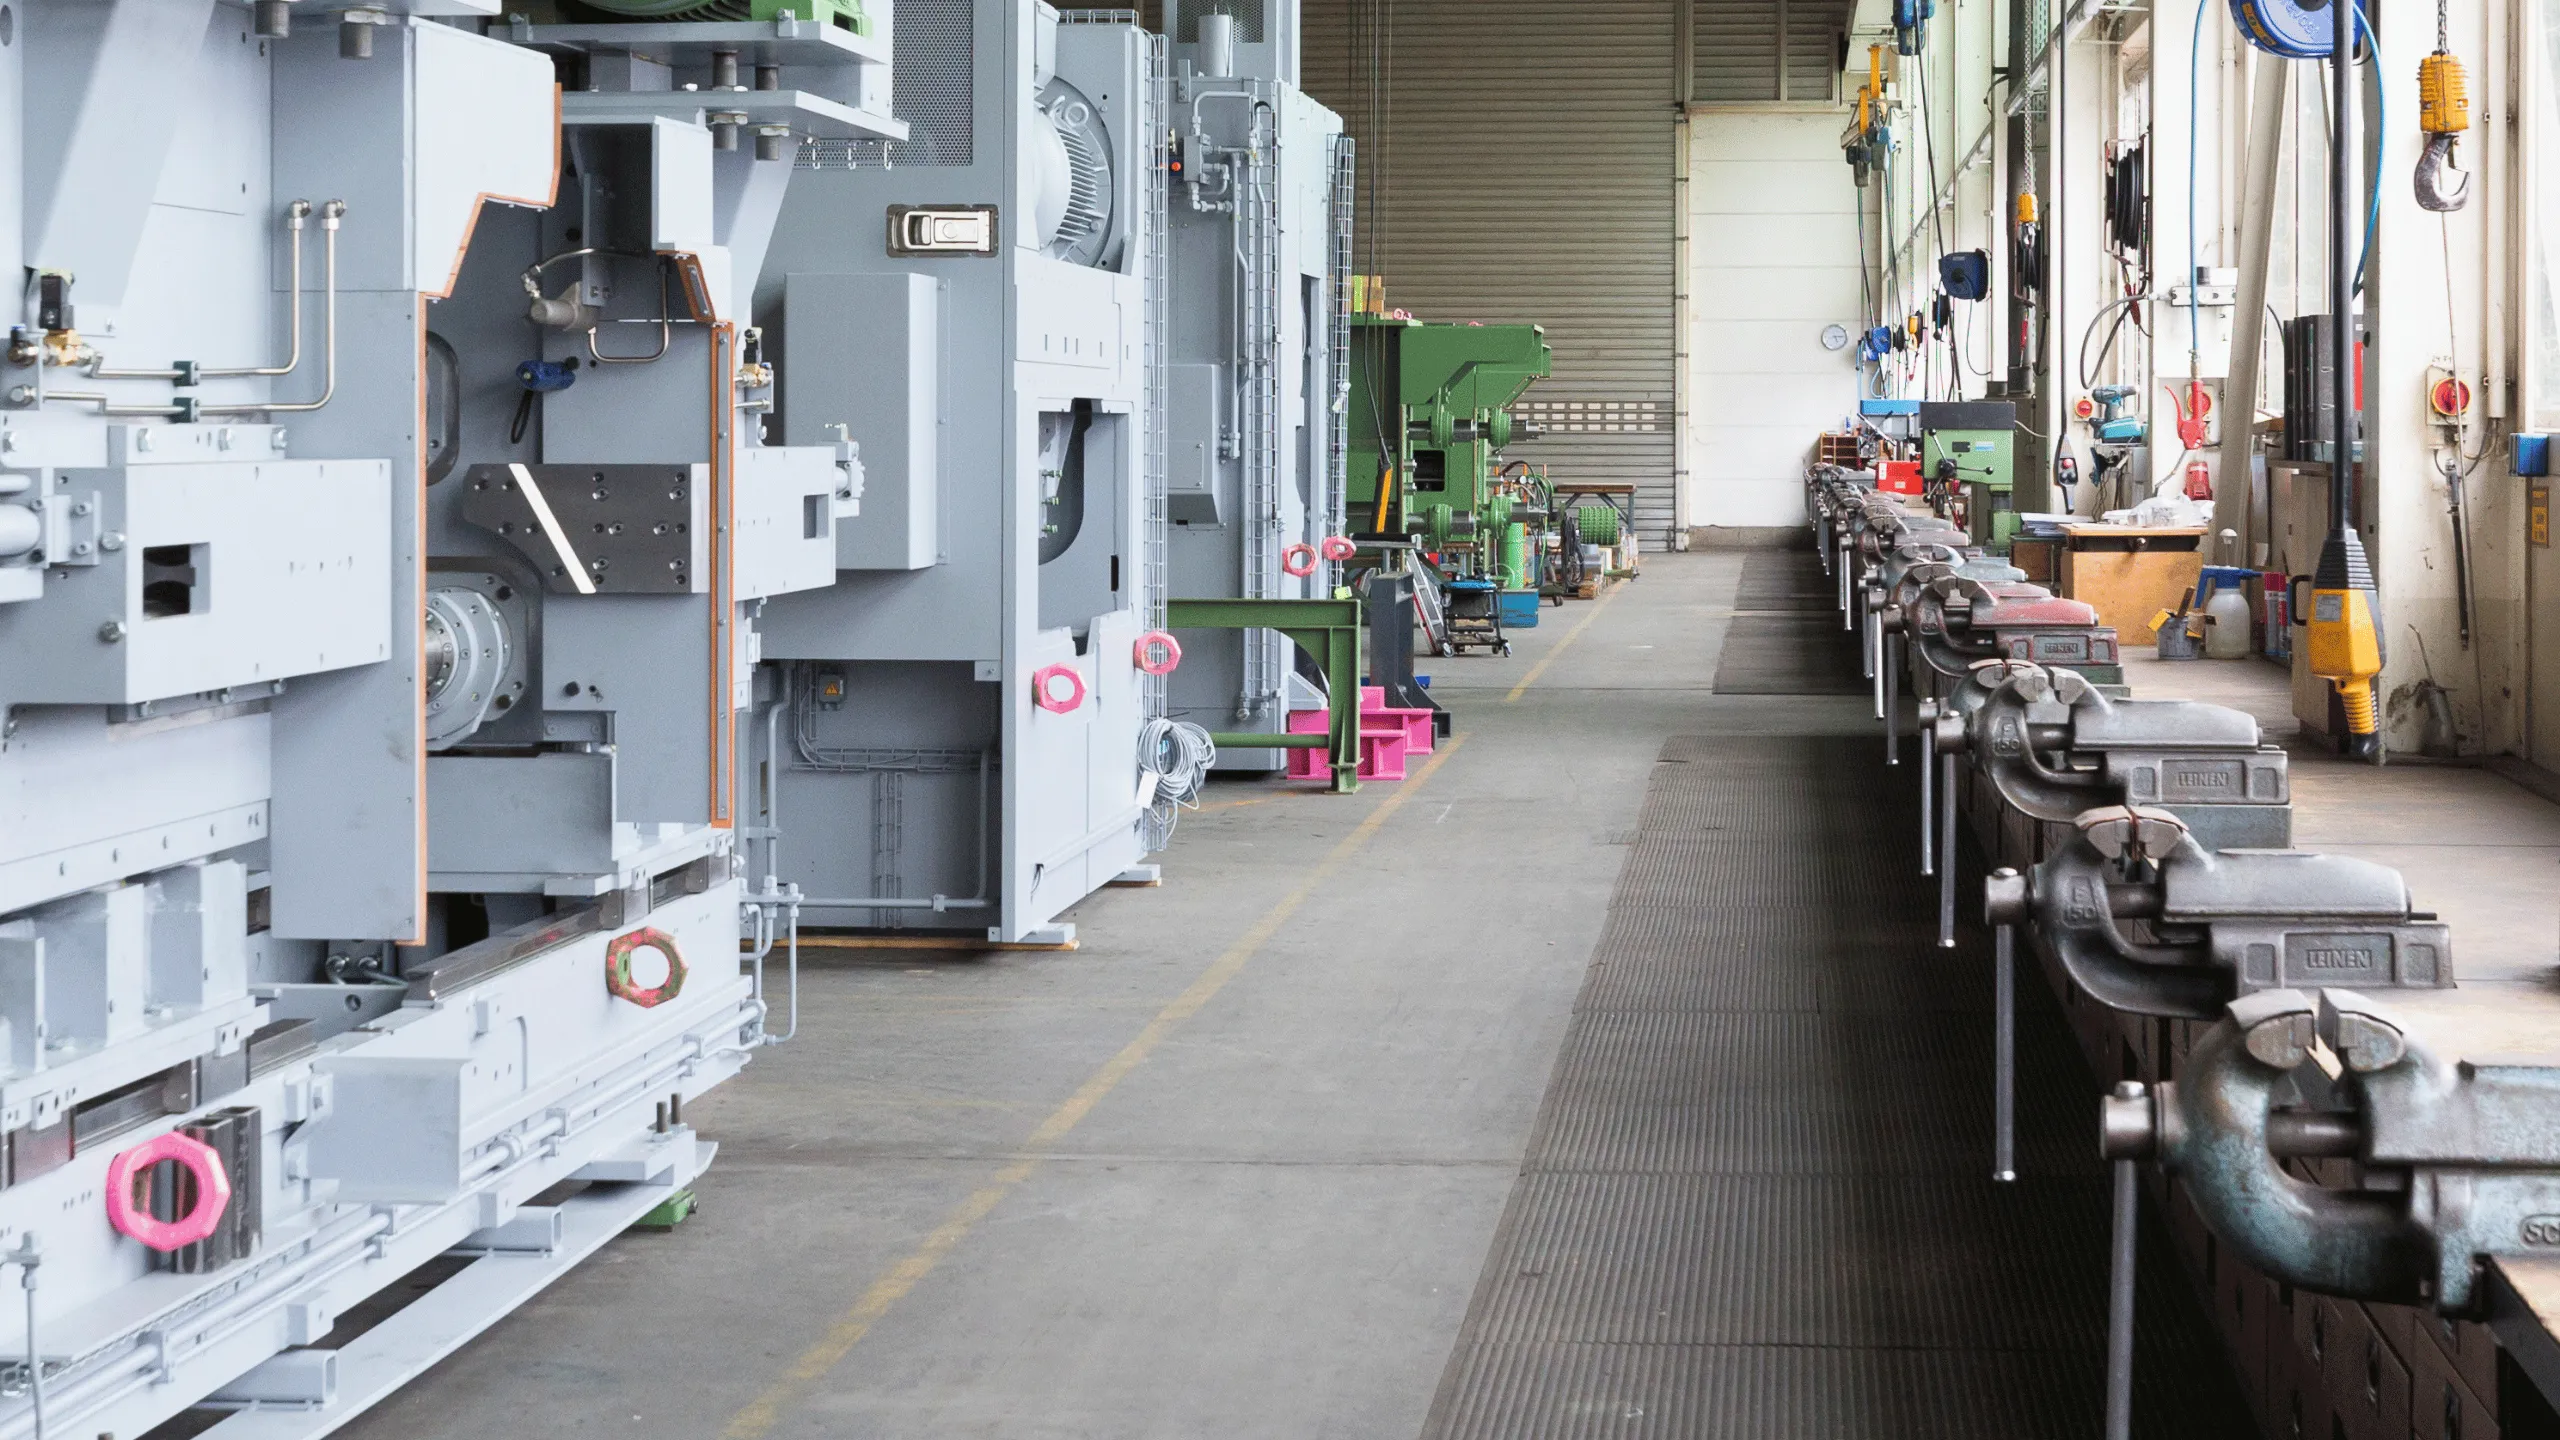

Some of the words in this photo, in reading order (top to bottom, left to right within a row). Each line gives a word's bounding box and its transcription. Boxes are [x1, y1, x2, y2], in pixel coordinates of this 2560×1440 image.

[2179, 772, 2228, 786] LEINEN
[2307, 949, 2372, 968] LEINEN
[2523, 1222, 2560, 1246] SC
